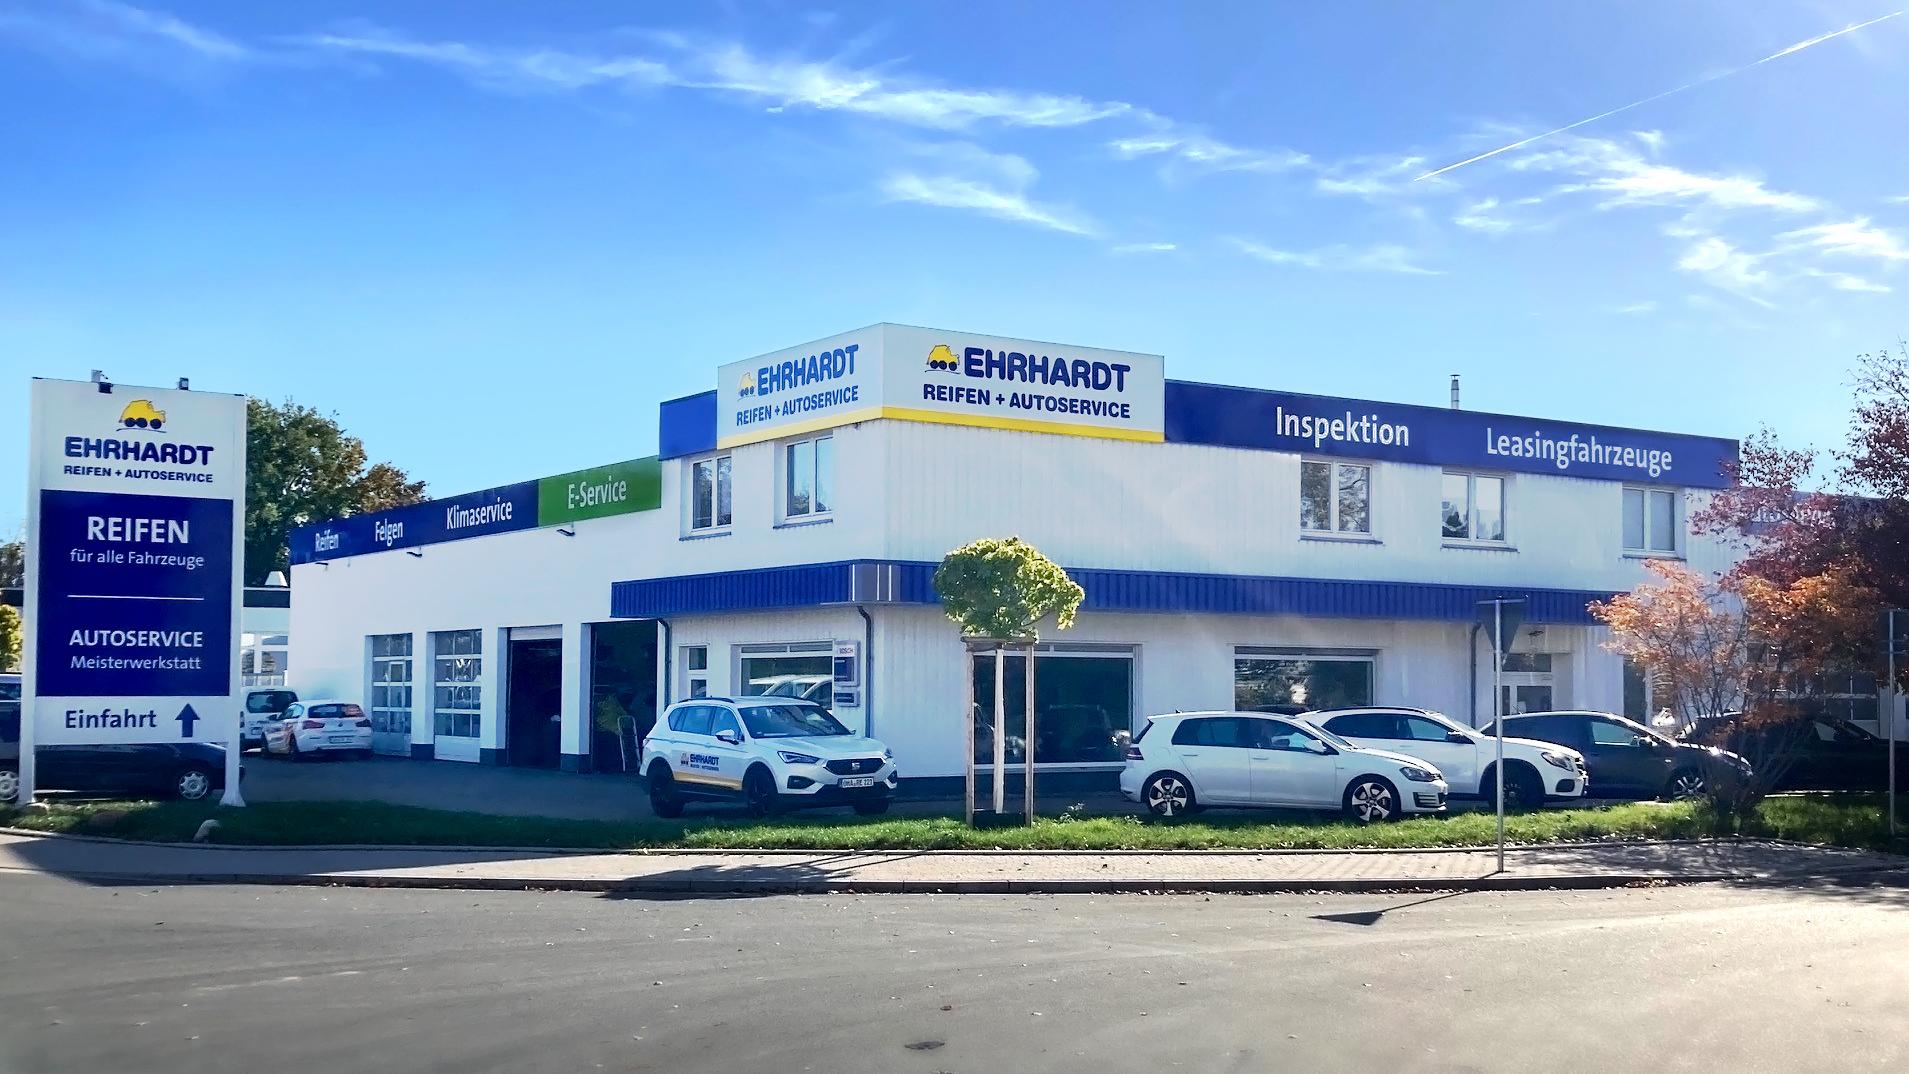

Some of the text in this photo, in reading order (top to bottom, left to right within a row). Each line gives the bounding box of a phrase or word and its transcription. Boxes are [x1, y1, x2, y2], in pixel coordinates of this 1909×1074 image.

[757, 344, 859, 396] EHRHARDT
[964, 347, 1131, 392] EHRHARDT
[736, 405, 772, 426] REIFEN
[782, 385, 859, 416] AUTOSERVICE
[923, 384, 1131, 419] REIFEN + AUTOSERVICE
[1275, 406, 1410, 448] Inspektion
[64, 436, 214, 466] EHRHARDT
[1486, 427, 1673, 478] Leasingfahrzeuge
[64, 465, 112, 477] REIFEN
[125, 469, 214, 483] AUTOSERVICE
[567, 475, 627, 510] E-Service
[446, 497, 513, 531] Klimaservice
[87, 516, 190, 544] REIFEN
[315, 532, 339, 552] Reifen
[374, 518, 404, 547] Felgen
[70, 548, 205, 570] für alle Fahrzeuge
[69, 629, 203, 648] AUTOSERVICE
[70, 655, 202, 670] Meisterwerkstatt
[65, 708, 158, 729] Einfahrt
